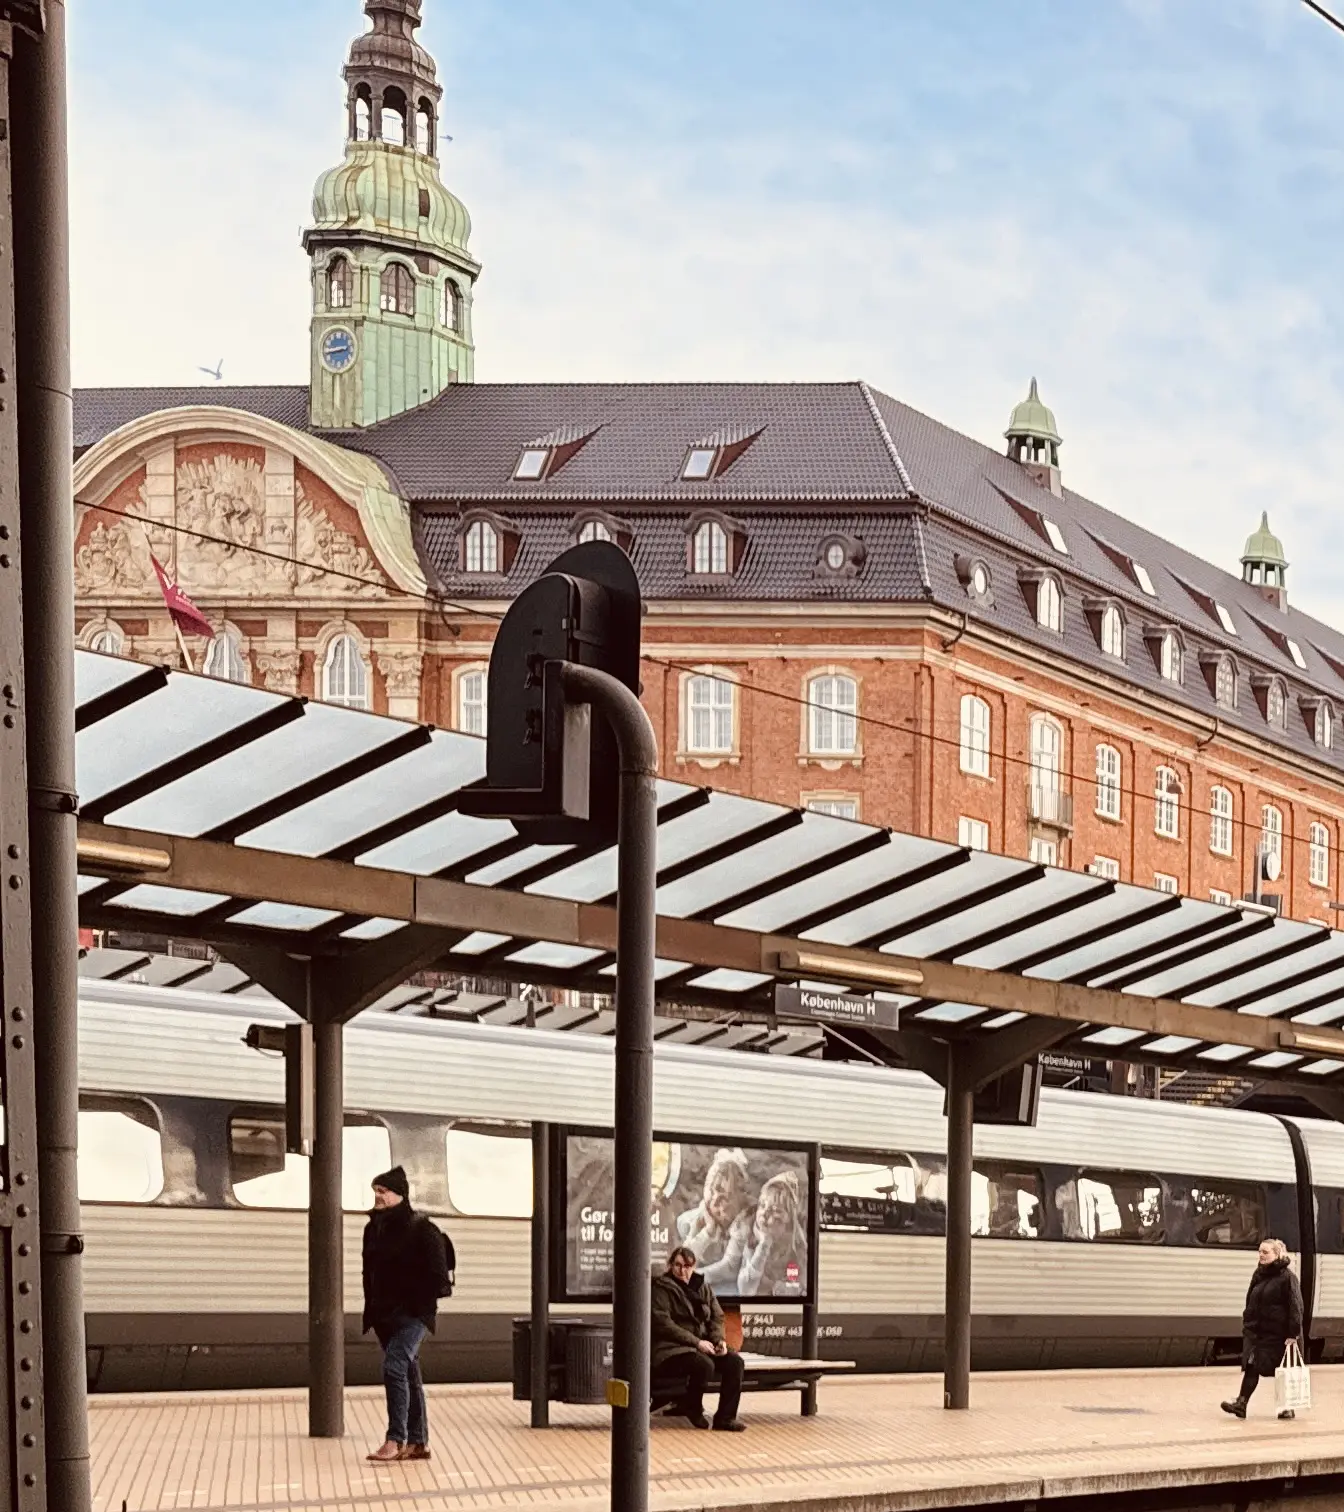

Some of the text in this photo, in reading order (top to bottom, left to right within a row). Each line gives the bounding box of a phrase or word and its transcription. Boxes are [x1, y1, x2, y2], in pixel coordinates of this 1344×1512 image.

[800, 991, 864, 1014] København
[866, 1001, 876, 1016] H
[1038, 1052, 1083, 1069] København
[1084, 1058, 1091, 1071] H
[580, 1206, 609, 1224] Gør
[580, 1224, 596, 1242] til
